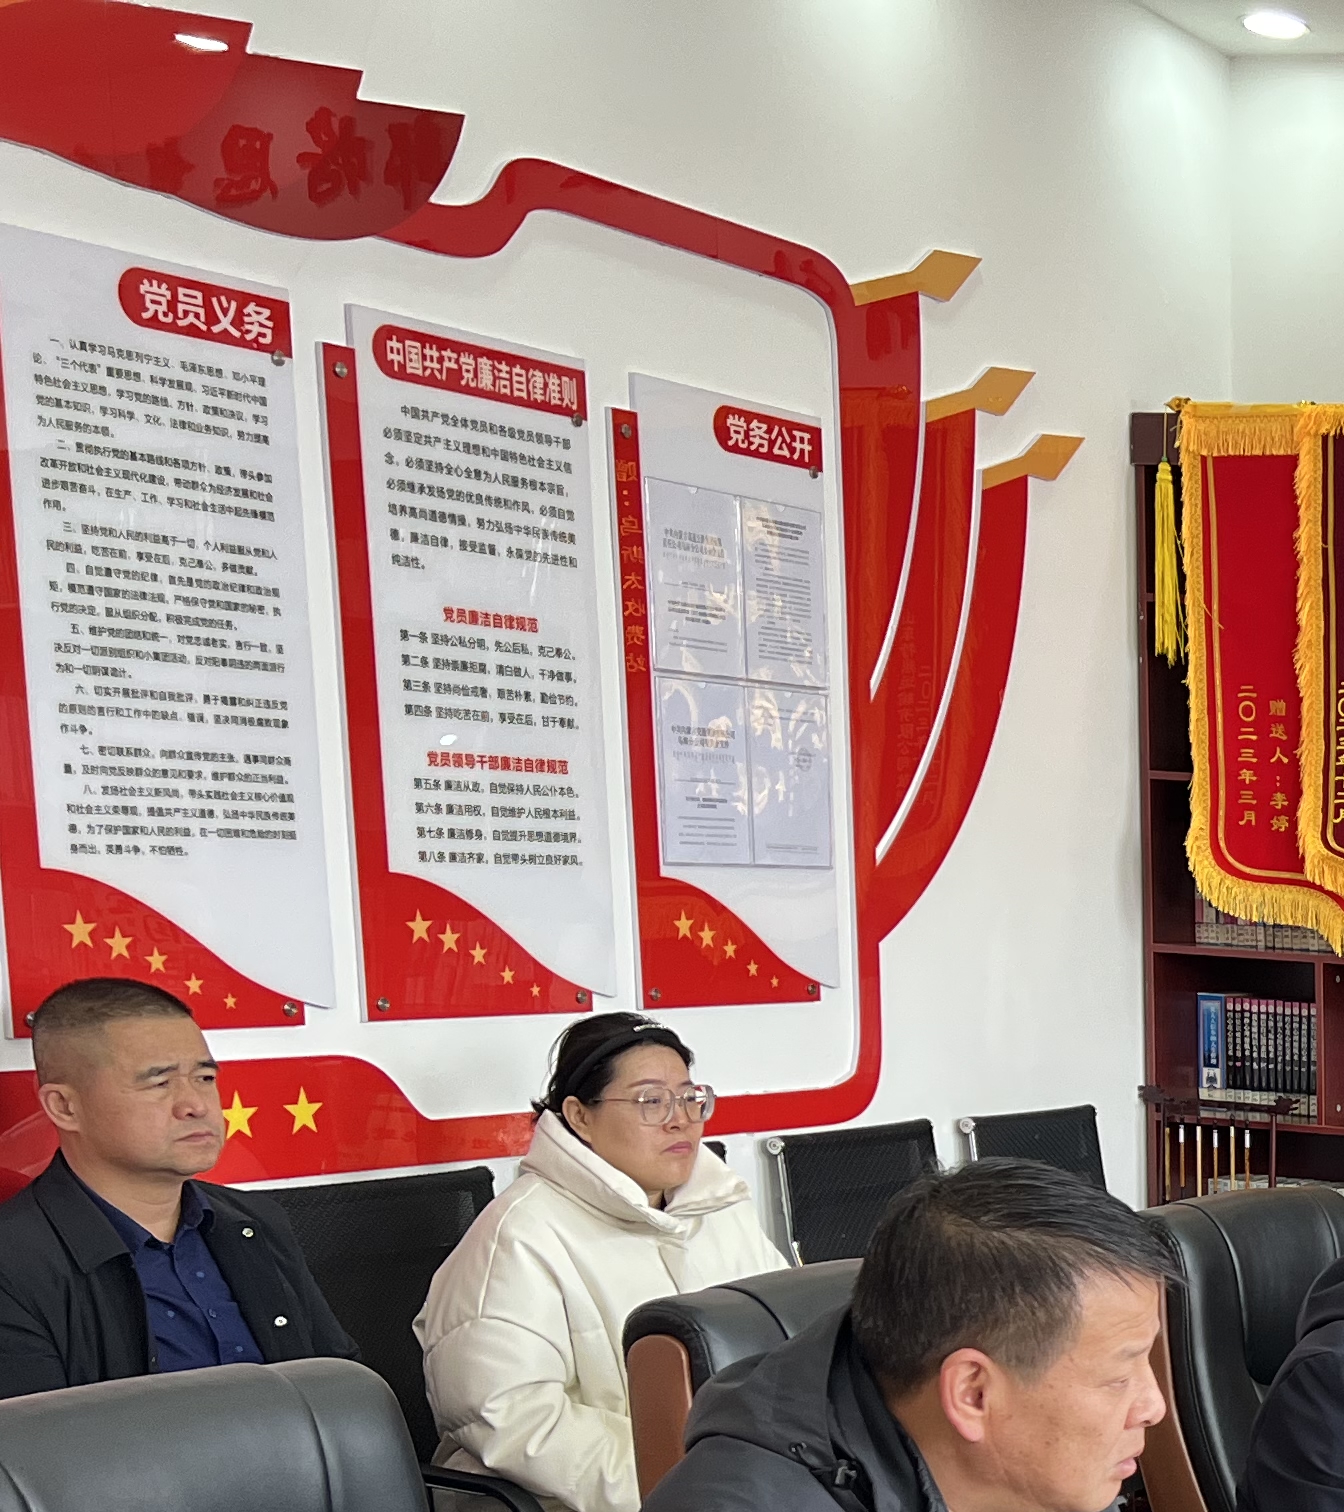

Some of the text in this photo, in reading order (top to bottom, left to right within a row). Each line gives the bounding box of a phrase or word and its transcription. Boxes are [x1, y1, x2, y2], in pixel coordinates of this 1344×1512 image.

[139, 277, 275, 345] 党员义务
[386, 335, 577, 410] 中国共产党廉洁自律准则
[726, 413, 813, 462] 党务公开
[443, 607, 538, 633] 党员廉洁自律规范
[427, 751, 569, 774] 党员领导干部廉洁自律规范
